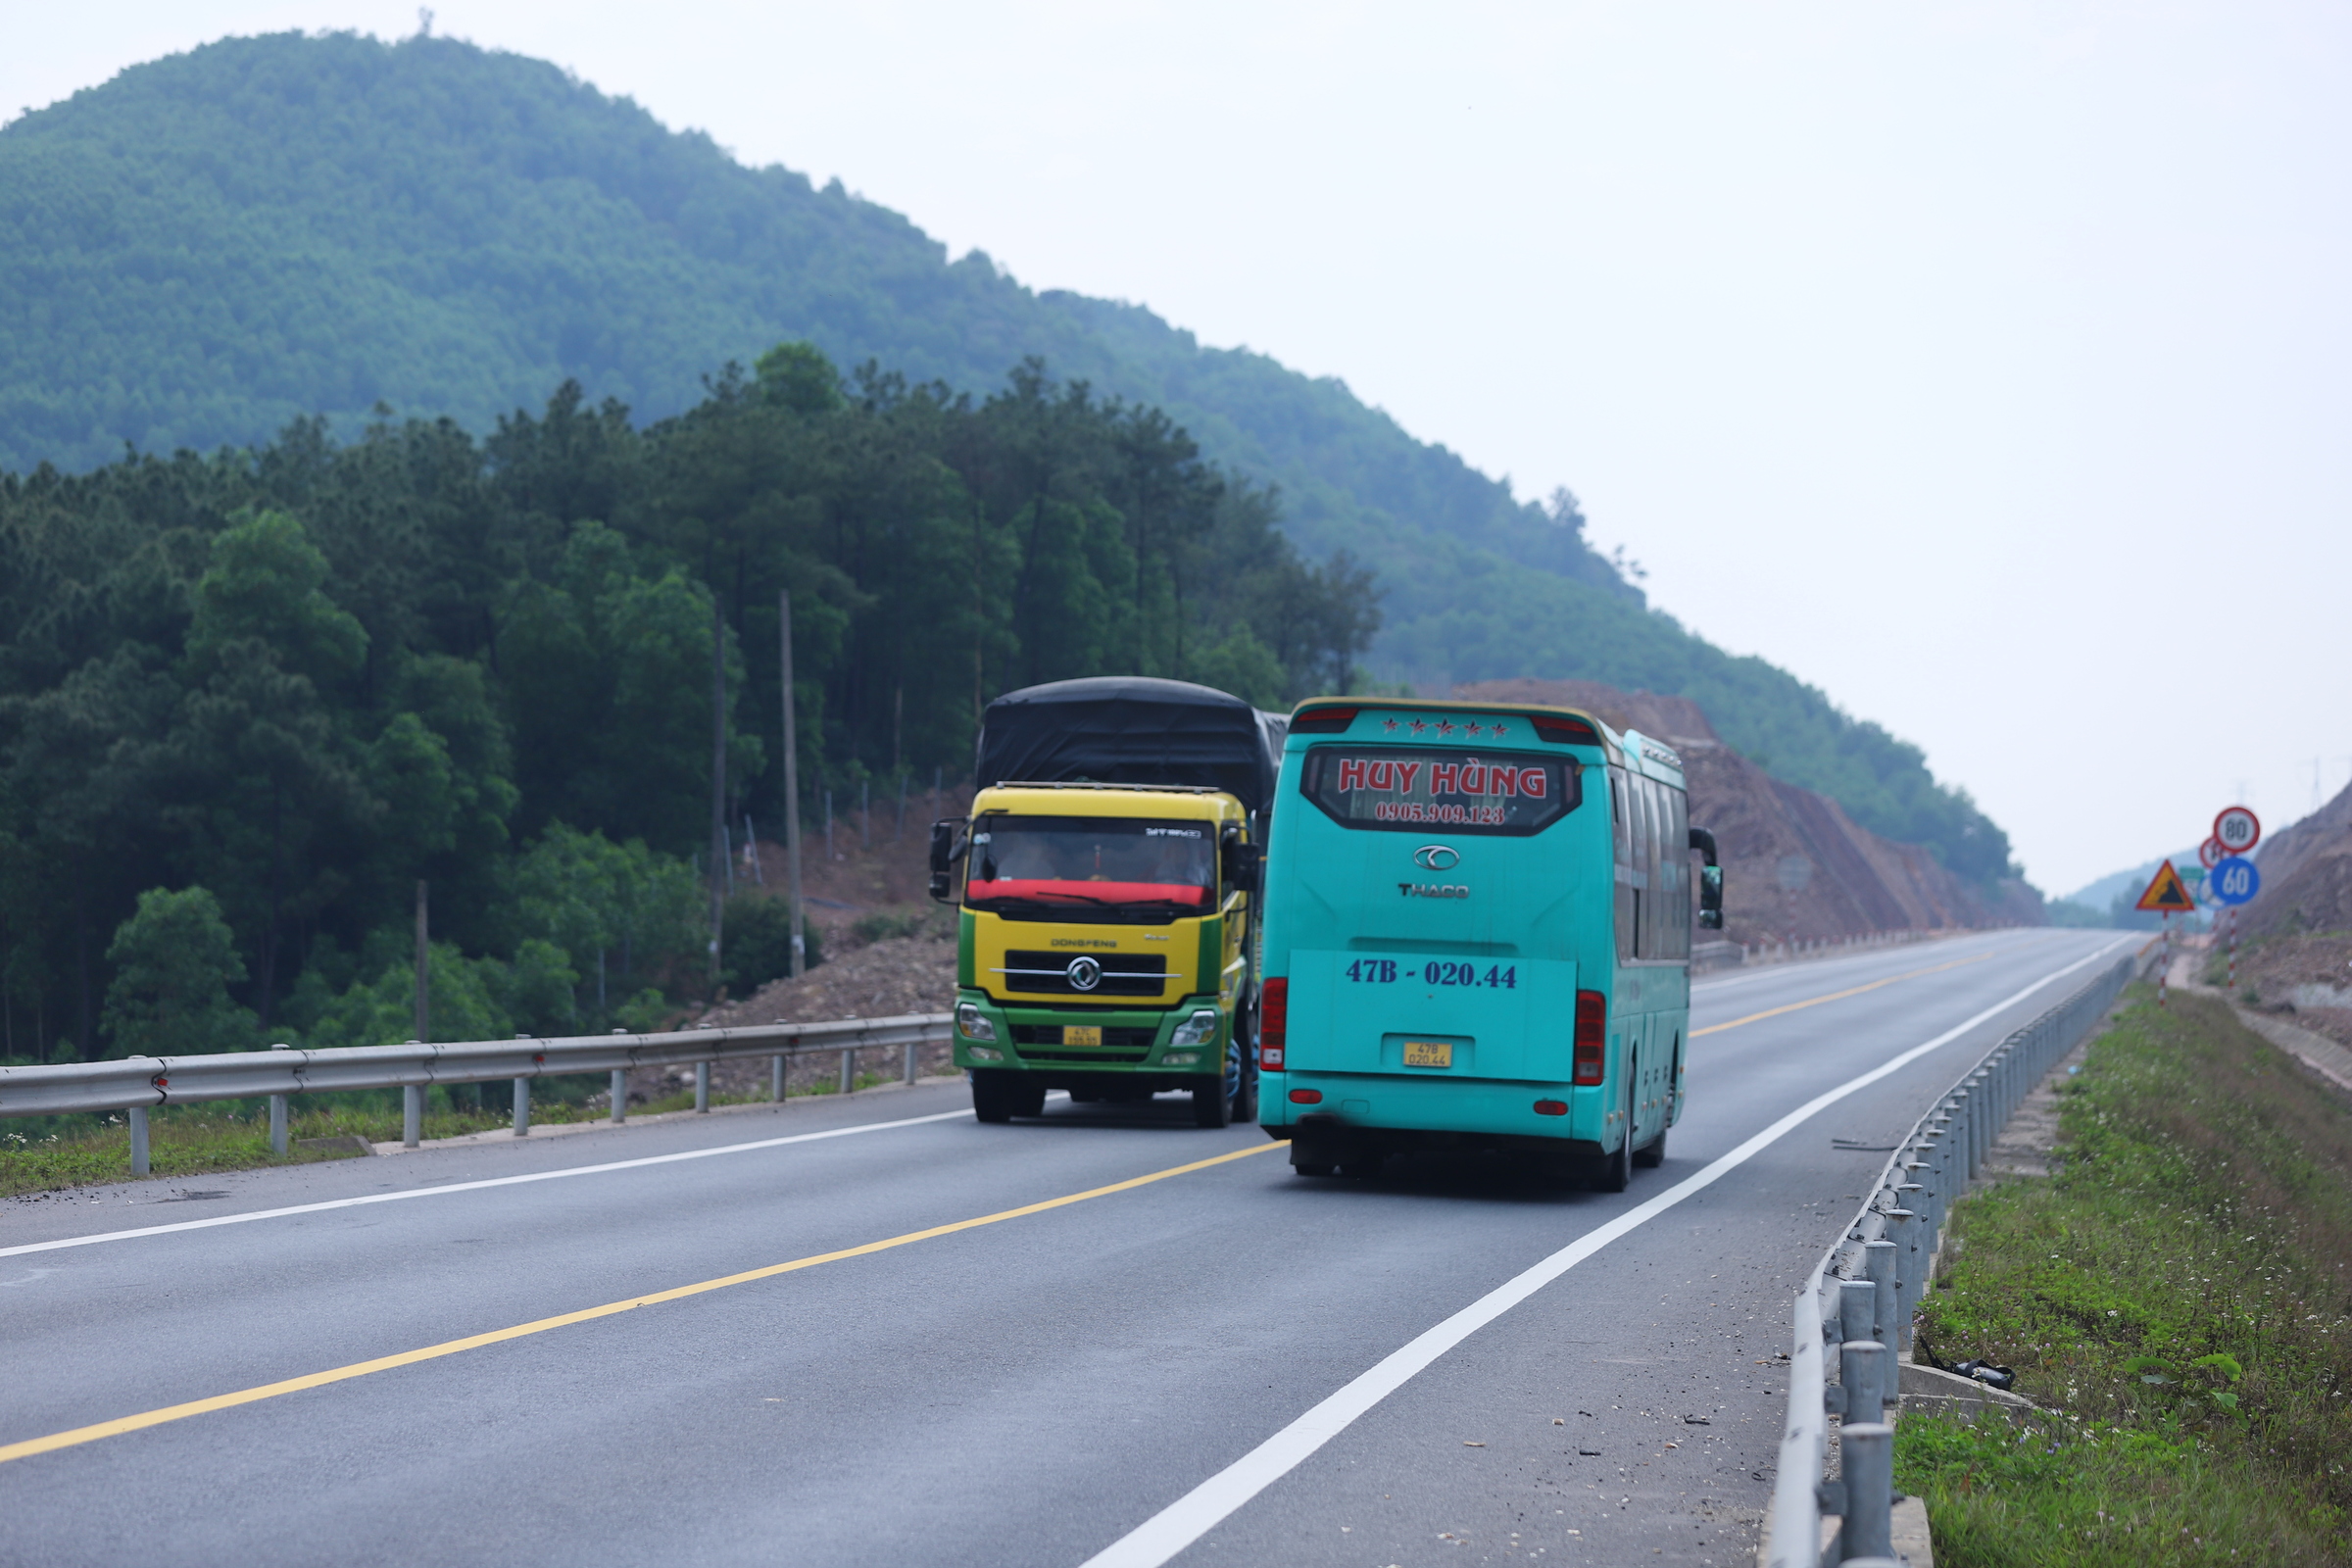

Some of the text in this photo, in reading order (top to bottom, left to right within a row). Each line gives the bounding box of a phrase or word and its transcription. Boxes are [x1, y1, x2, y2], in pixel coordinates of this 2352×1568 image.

[1339, 758, 1546, 799] HUY HÙNG
[1375, 802, 1505, 825] 0905.909.123
[2226, 819, 2247, 841] 80
[1398, 883, 1469, 899] THACO
[2222, 866, 2250, 895] 60
[1346, 958, 1397, 983] 47B
[1424, 960, 1517, 989] 020.44
[1418, 1044, 1439, 1054] 47B
